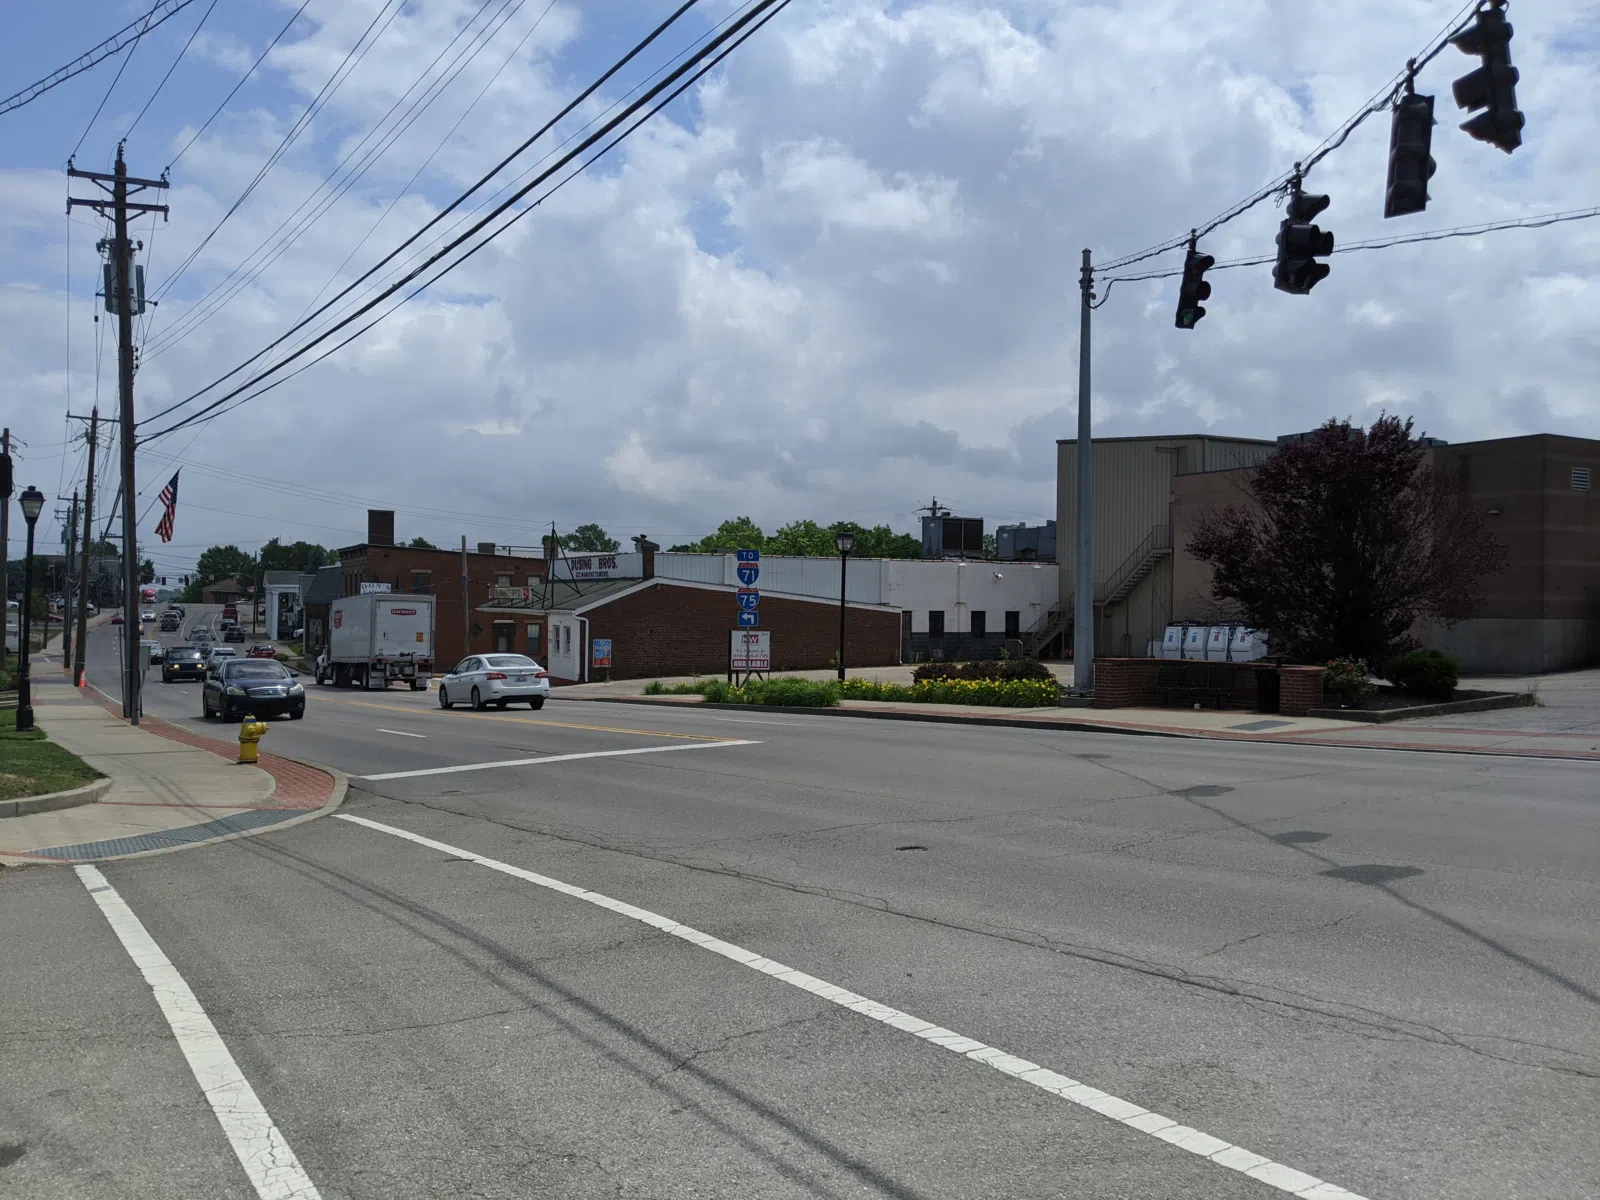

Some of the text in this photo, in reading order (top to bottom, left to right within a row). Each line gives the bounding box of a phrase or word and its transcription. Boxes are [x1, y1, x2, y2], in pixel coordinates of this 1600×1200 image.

[741, 551, 754, 559] TO
[570, 556, 618, 571] DUSING BROS.
[742, 570, 755, 582] 71
[740, 595, 757, 607] 75
[733, 660, 768, 668] AVALABLE
